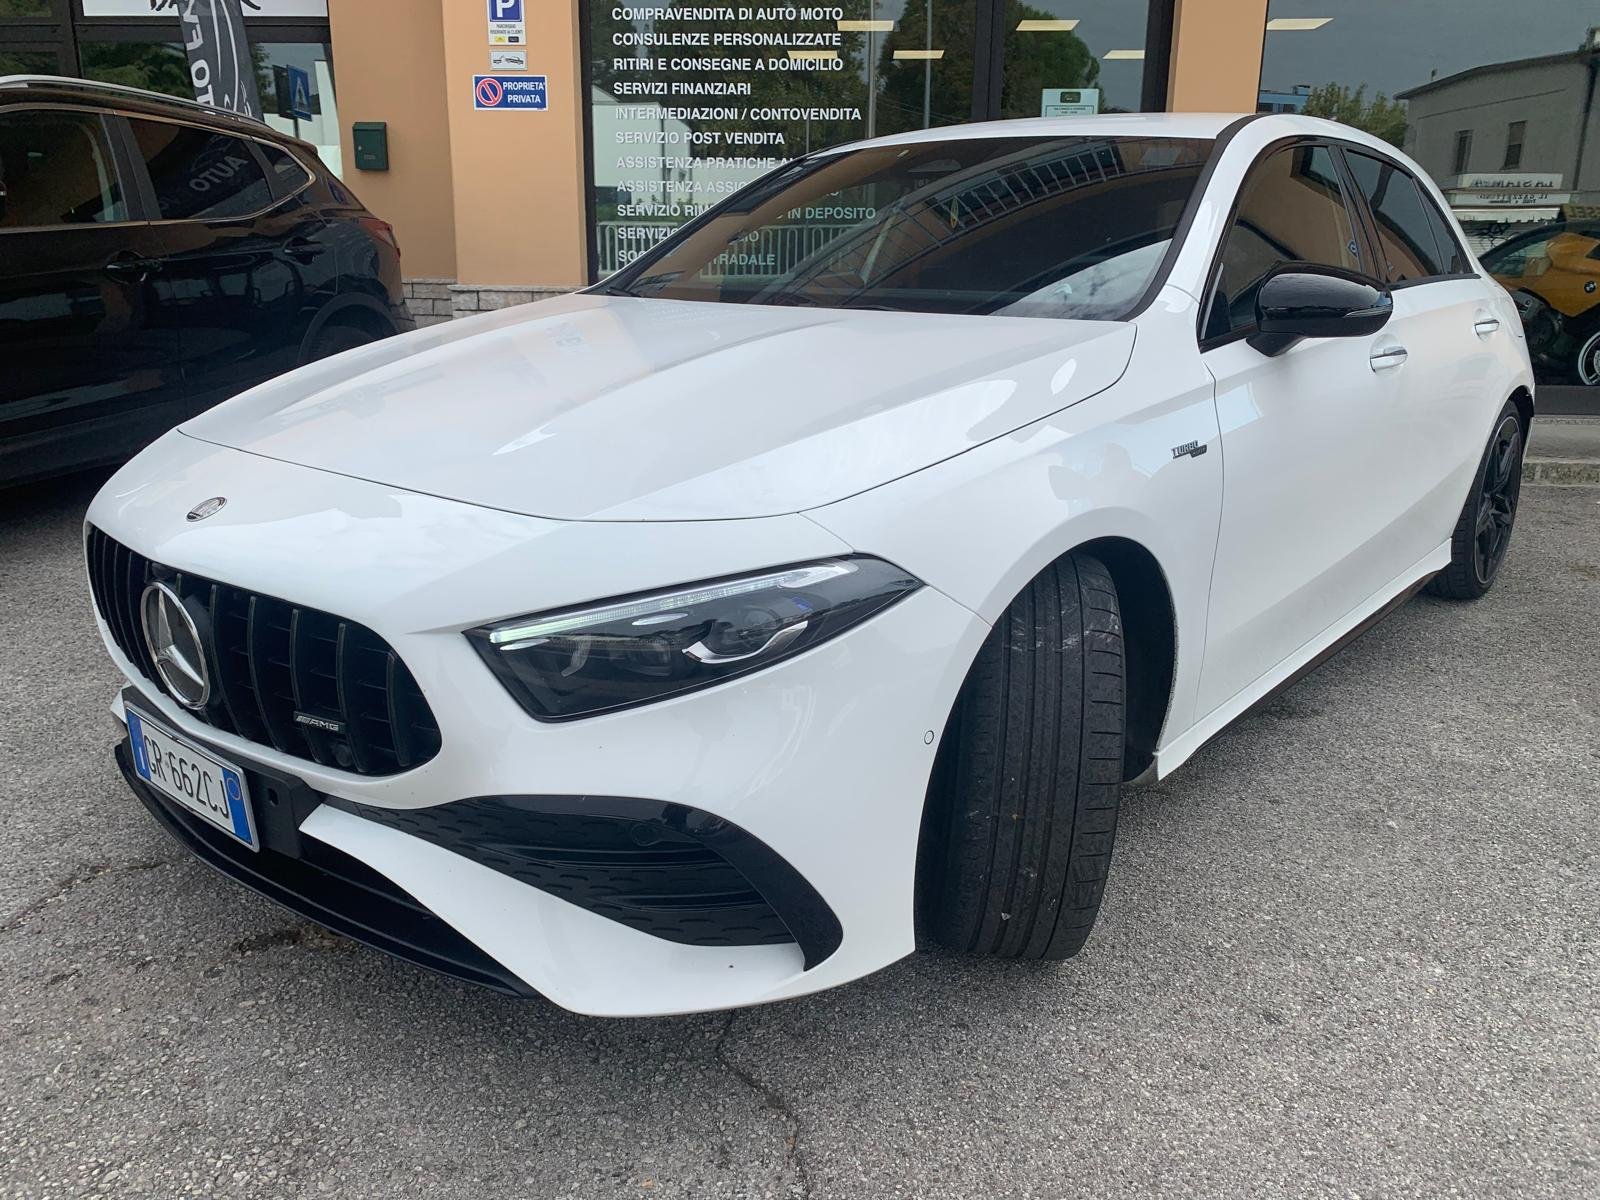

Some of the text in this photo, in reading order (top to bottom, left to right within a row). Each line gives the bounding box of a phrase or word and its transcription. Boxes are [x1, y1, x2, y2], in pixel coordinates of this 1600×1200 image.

[612, 7, 843, 21] COMPRAVENDITA DI AUTO MOTO
[612, 33, 842, 46] CONSULENZE PERSONALIZZATE
[613, 58, 843, 71] RITIRI E CONSEGNE A DOMICILIO
[613, 83, 751, 95] SERVIZI FINANZIARI
[507, 94, 541, 104] PRIVATA
[615, 107, 738, 120] INTERMEDIAZIONI
[750, 108, 862, 120] CONTOVENDITA
[615, 132, 785, 145] SERVIZIO POST VENDITA
[616, 156, 702, 169] ASSISTENZA
[706, 157, 776, 169] PRATICHE
[616, 180, 702, 193] ASSISTENZA
[617, 204, 681, 217] SERVIZIO
[787, 208, 801, 219] IN
[805, 207, 876, 219] DEPOSITO
[309, 718, 339, 731] AMG
